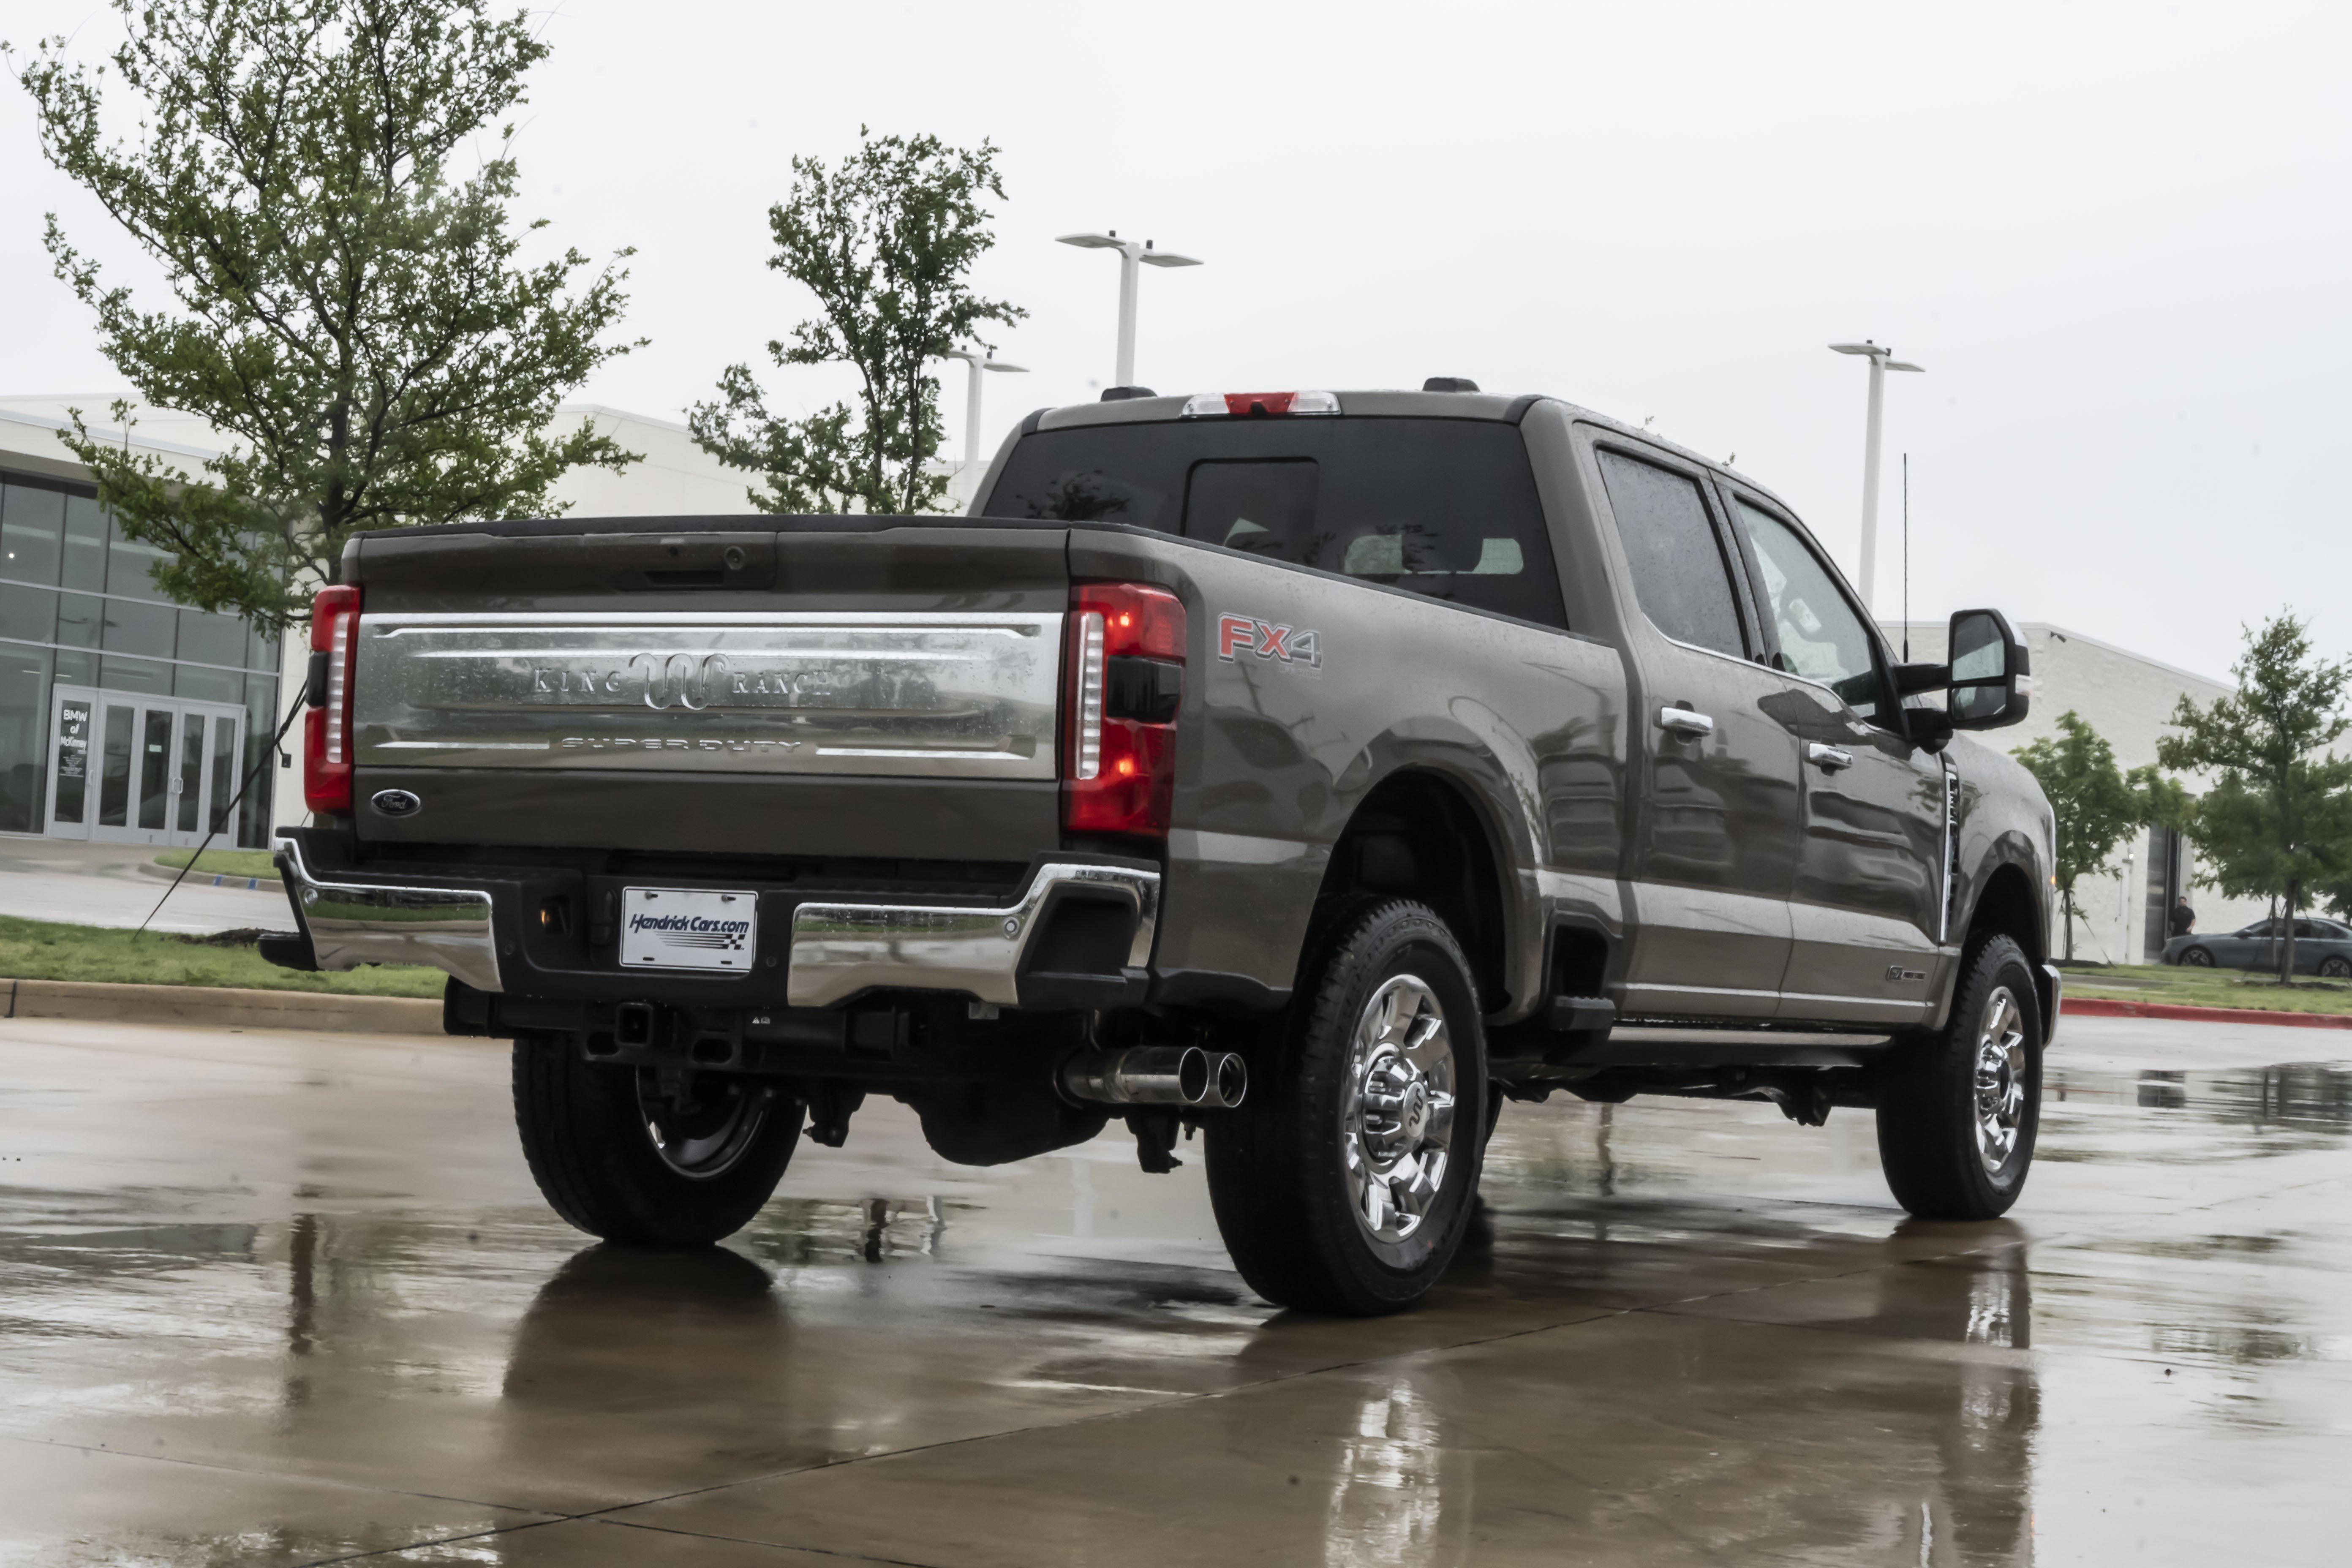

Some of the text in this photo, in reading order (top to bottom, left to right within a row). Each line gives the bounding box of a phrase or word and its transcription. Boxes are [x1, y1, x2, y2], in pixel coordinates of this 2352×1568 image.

[1218, 612, 1323, 670] FX4
[534, 667, 832, 695] KING RANCH
[63, 709, 88, 721] BMW
[70, 723, 80, 734] of
[562, 737, 801, 753] SUPER DUTY
[381, 794, 408, 809] Ford
